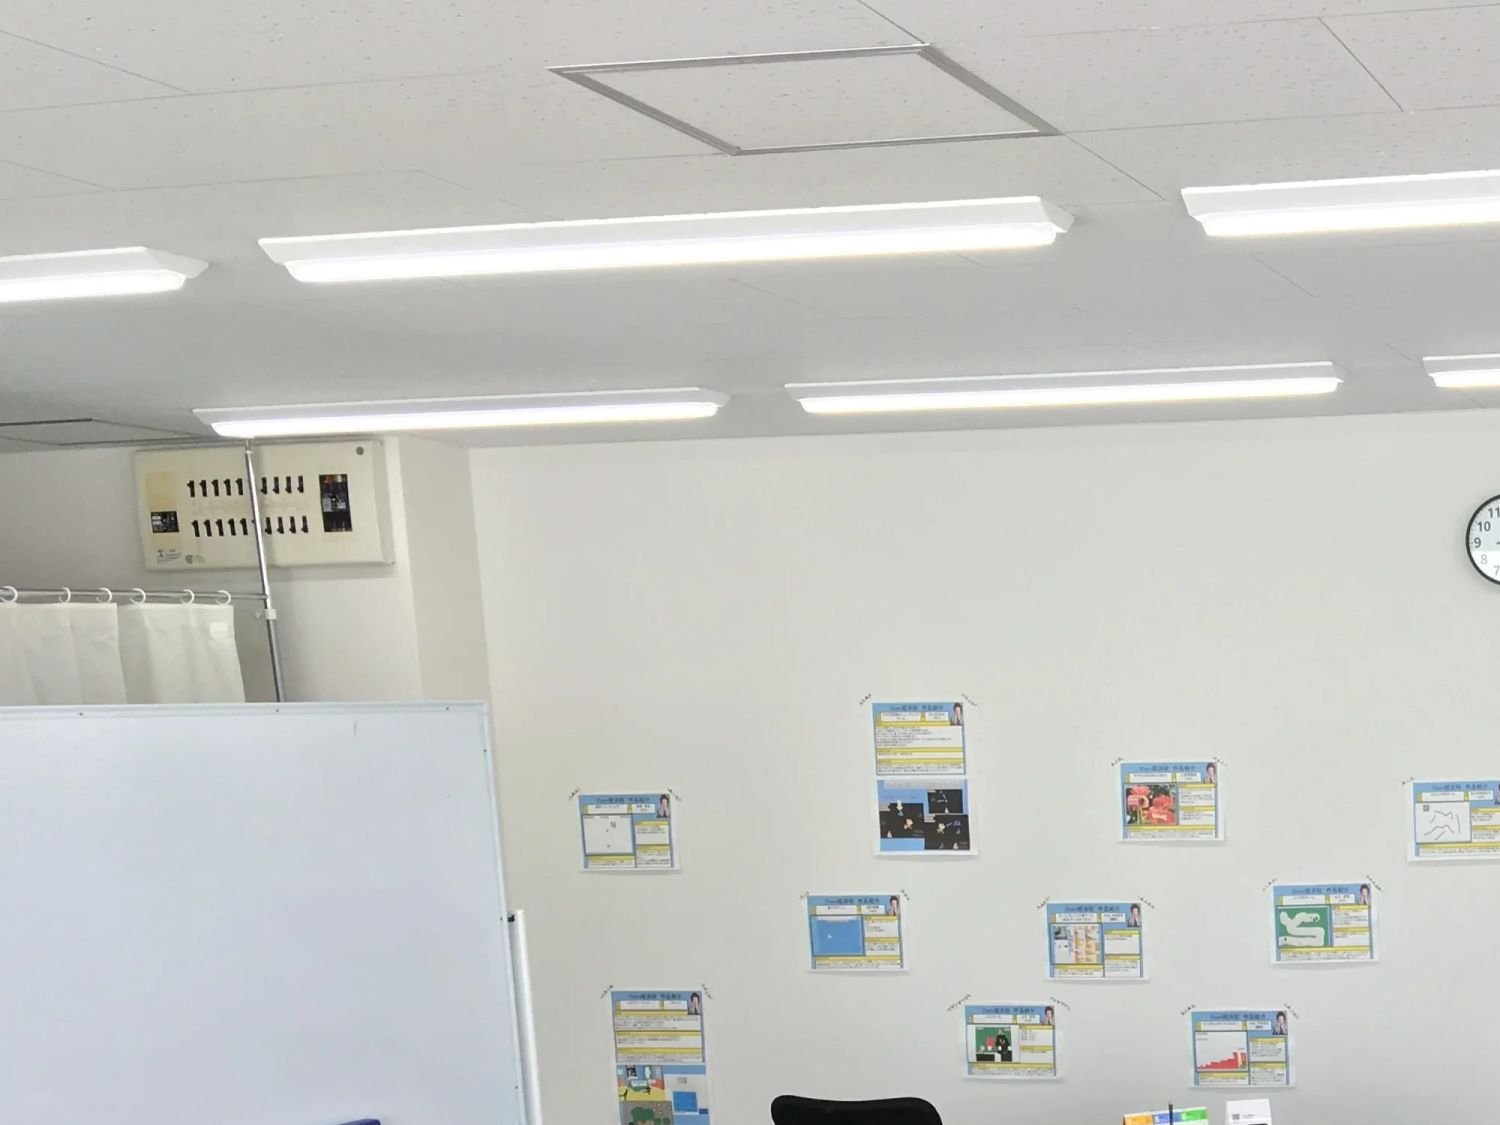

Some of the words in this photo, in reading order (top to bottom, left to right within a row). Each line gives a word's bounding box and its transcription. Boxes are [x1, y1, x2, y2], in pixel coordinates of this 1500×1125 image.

[1488, 506, 1500, 518] 11
[1478, 521, 1491, 532] 10
[1474, 537, 1481, 548] 9
[1480, 554, 1488, 565] 8
[1493, 565, 1500, 576] 7
